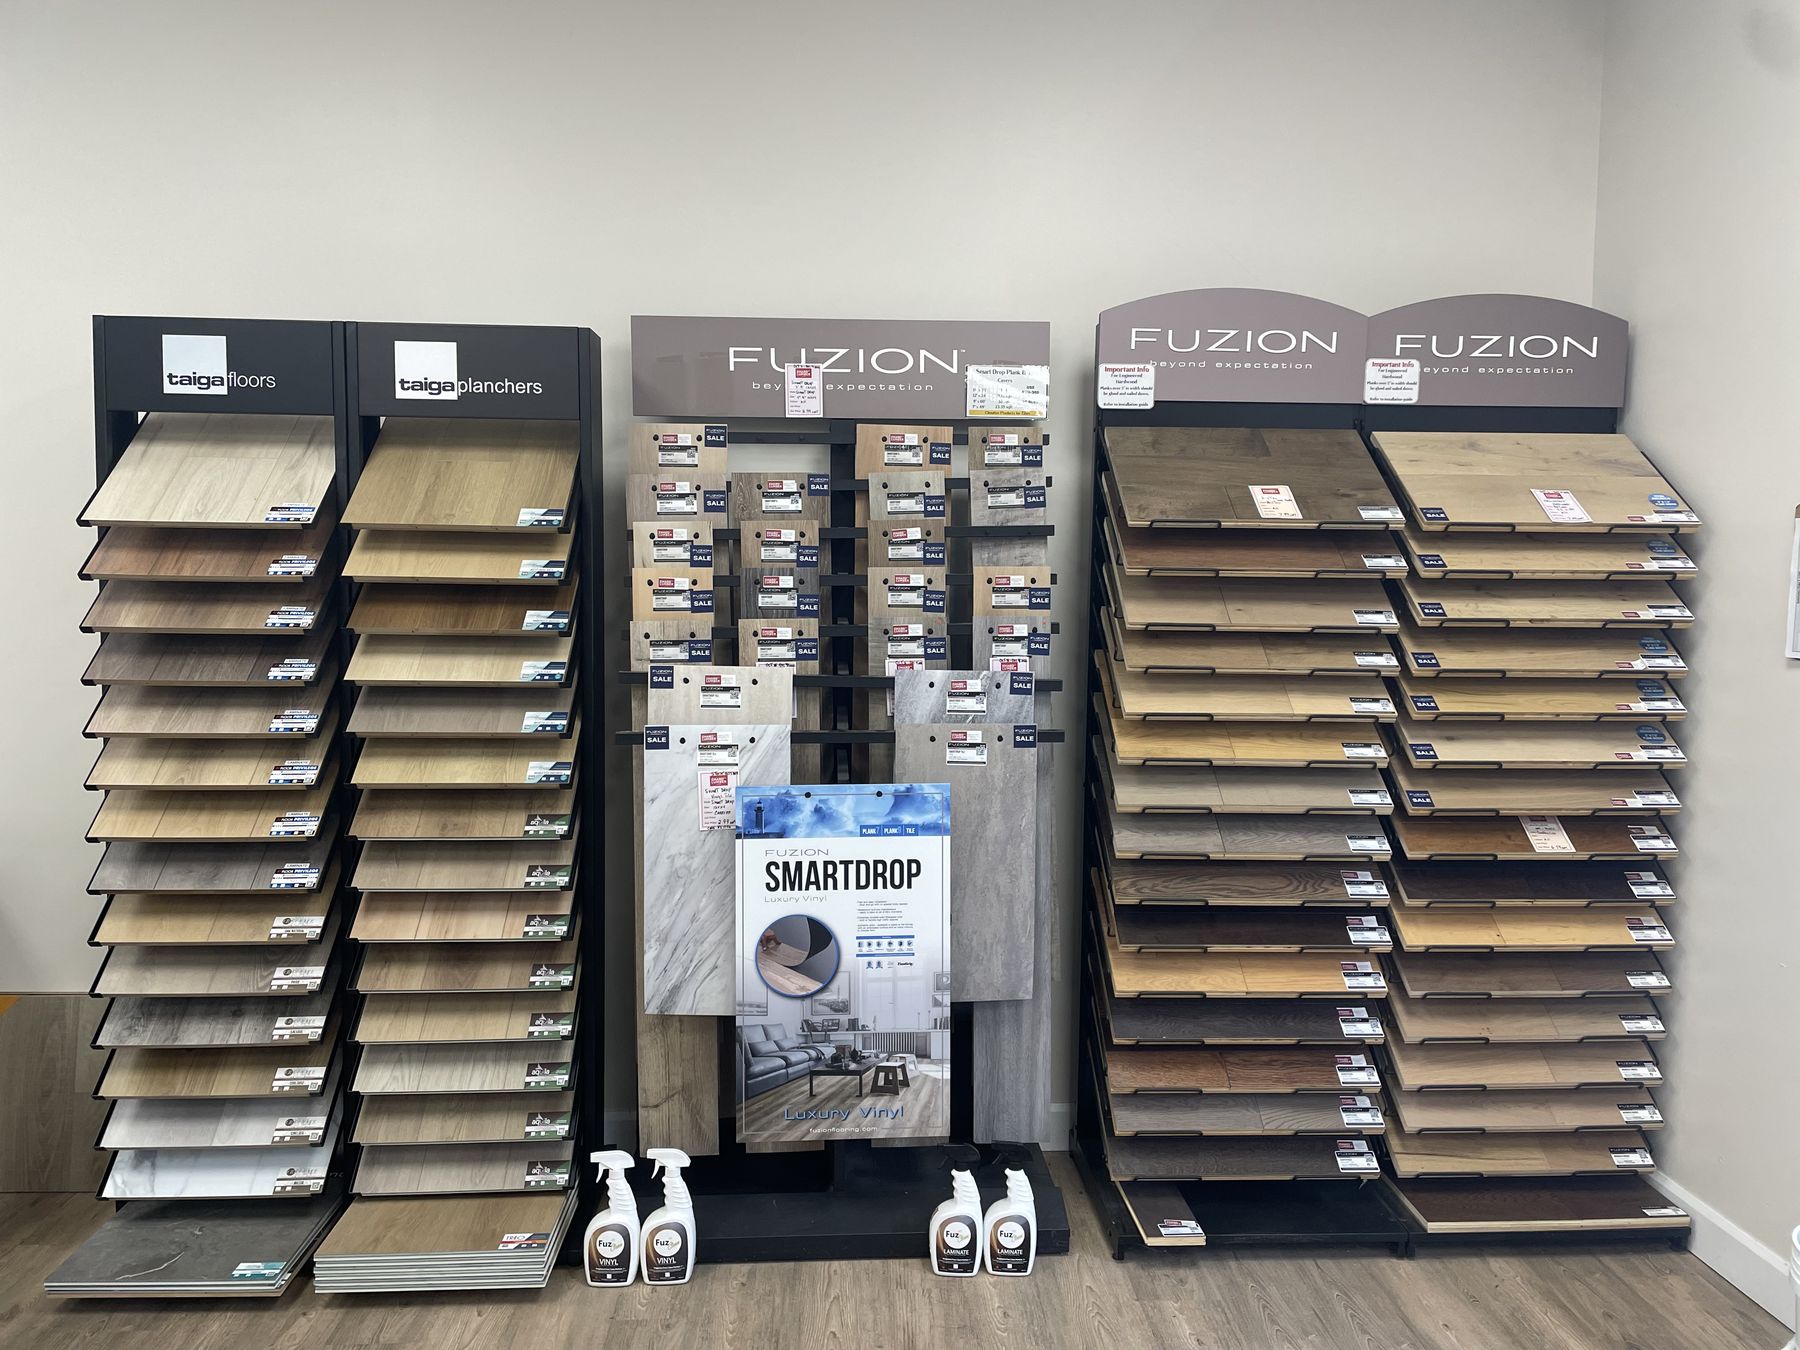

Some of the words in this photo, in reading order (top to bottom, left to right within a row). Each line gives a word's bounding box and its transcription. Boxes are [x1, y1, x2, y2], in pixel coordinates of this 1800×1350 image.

[1130, 328, 1338, 354] FUZION
[1395, 334, 1598, 359] FUZION
[728, 347, 958, 374] FUZION
[1150, 360, 1206, 369] beyond
[1215, 362, 1313, 370] expectation
[1104, 366, 1136, 374] Important
[1423, 366, 1469, 374] eyond
[752, 381, 781, 391] bey
[826, 383, 933, 391] expectation
[765, 859, 922, 892] SMARTDROP
[764, 896, 800, 904] Luxury
[802, 895, 827, 903] Vinyl
[783, 1108, 850, 1121] Luxury
[859, 1106, 904, 1120] Vinyl
[809, 1126, 878, 1134] fuzionflooring.com
